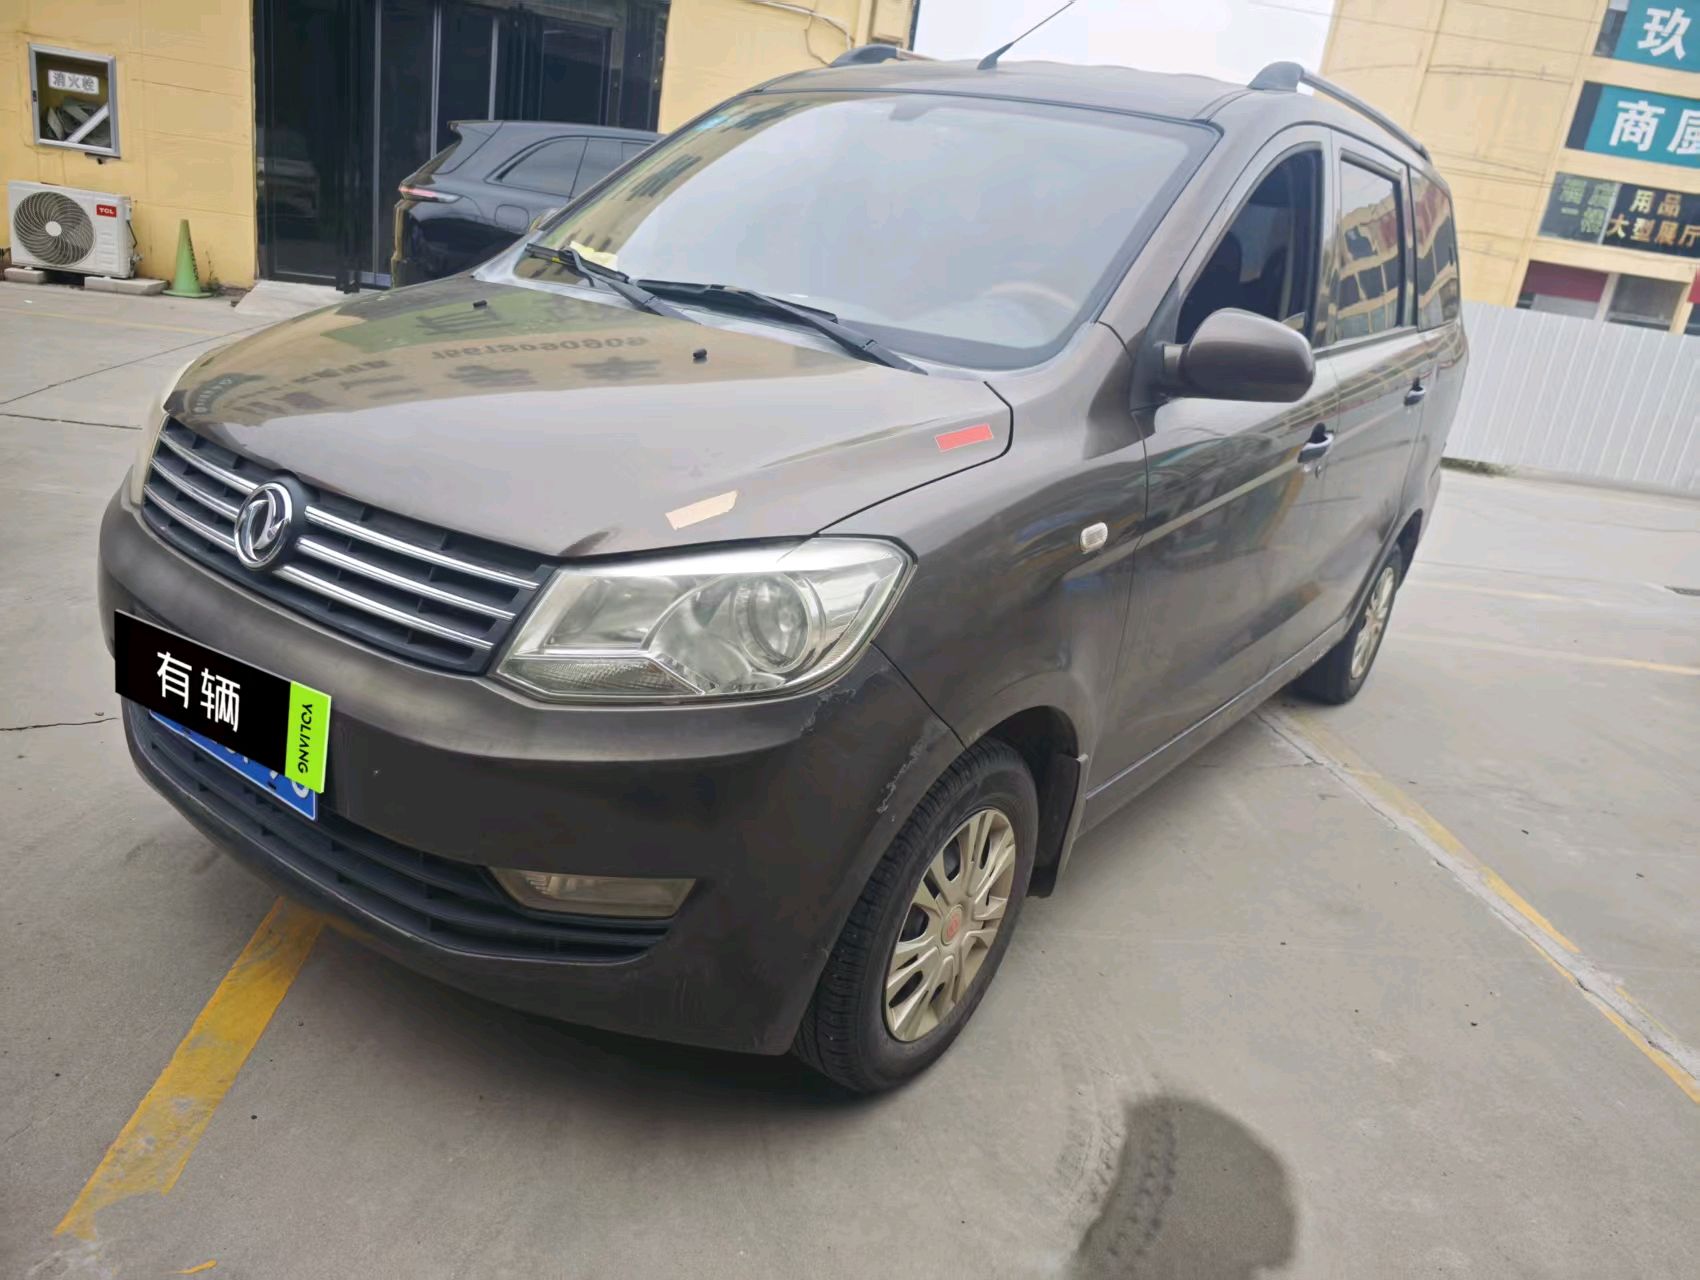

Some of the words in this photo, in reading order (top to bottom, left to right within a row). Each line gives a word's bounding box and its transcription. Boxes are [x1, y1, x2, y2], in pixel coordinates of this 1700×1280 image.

[1637, 8, 1692, 60] 玖
[53, 72, 96, 91] 消火栓
[99, 206, 114, 215] TCL
